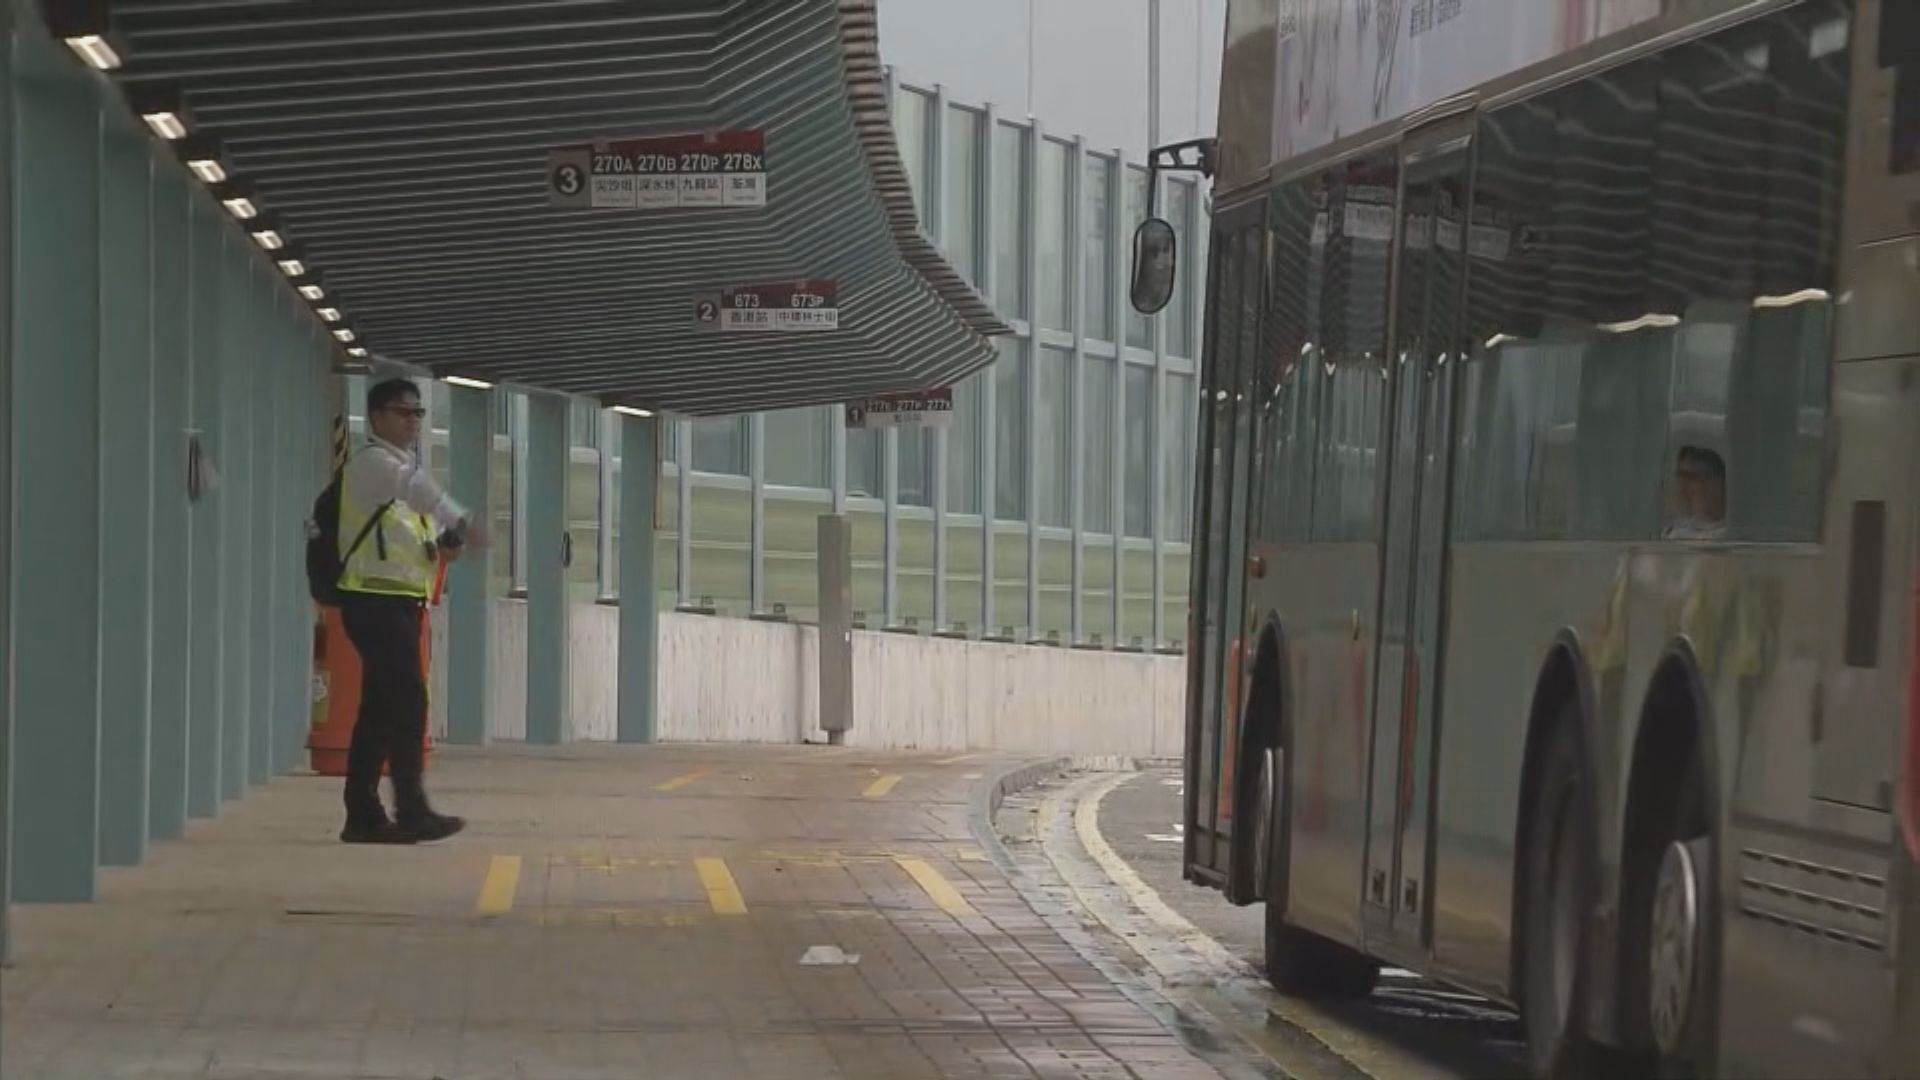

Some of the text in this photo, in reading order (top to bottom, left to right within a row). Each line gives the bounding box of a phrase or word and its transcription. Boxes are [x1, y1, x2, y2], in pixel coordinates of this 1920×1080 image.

[594, 151, 762, 173] 270A 270B 270P 278X
[559, 166, 579, 194] 3
[735, 294, 824, 308] 673 673P
[701, 302, 713, 321] 2
